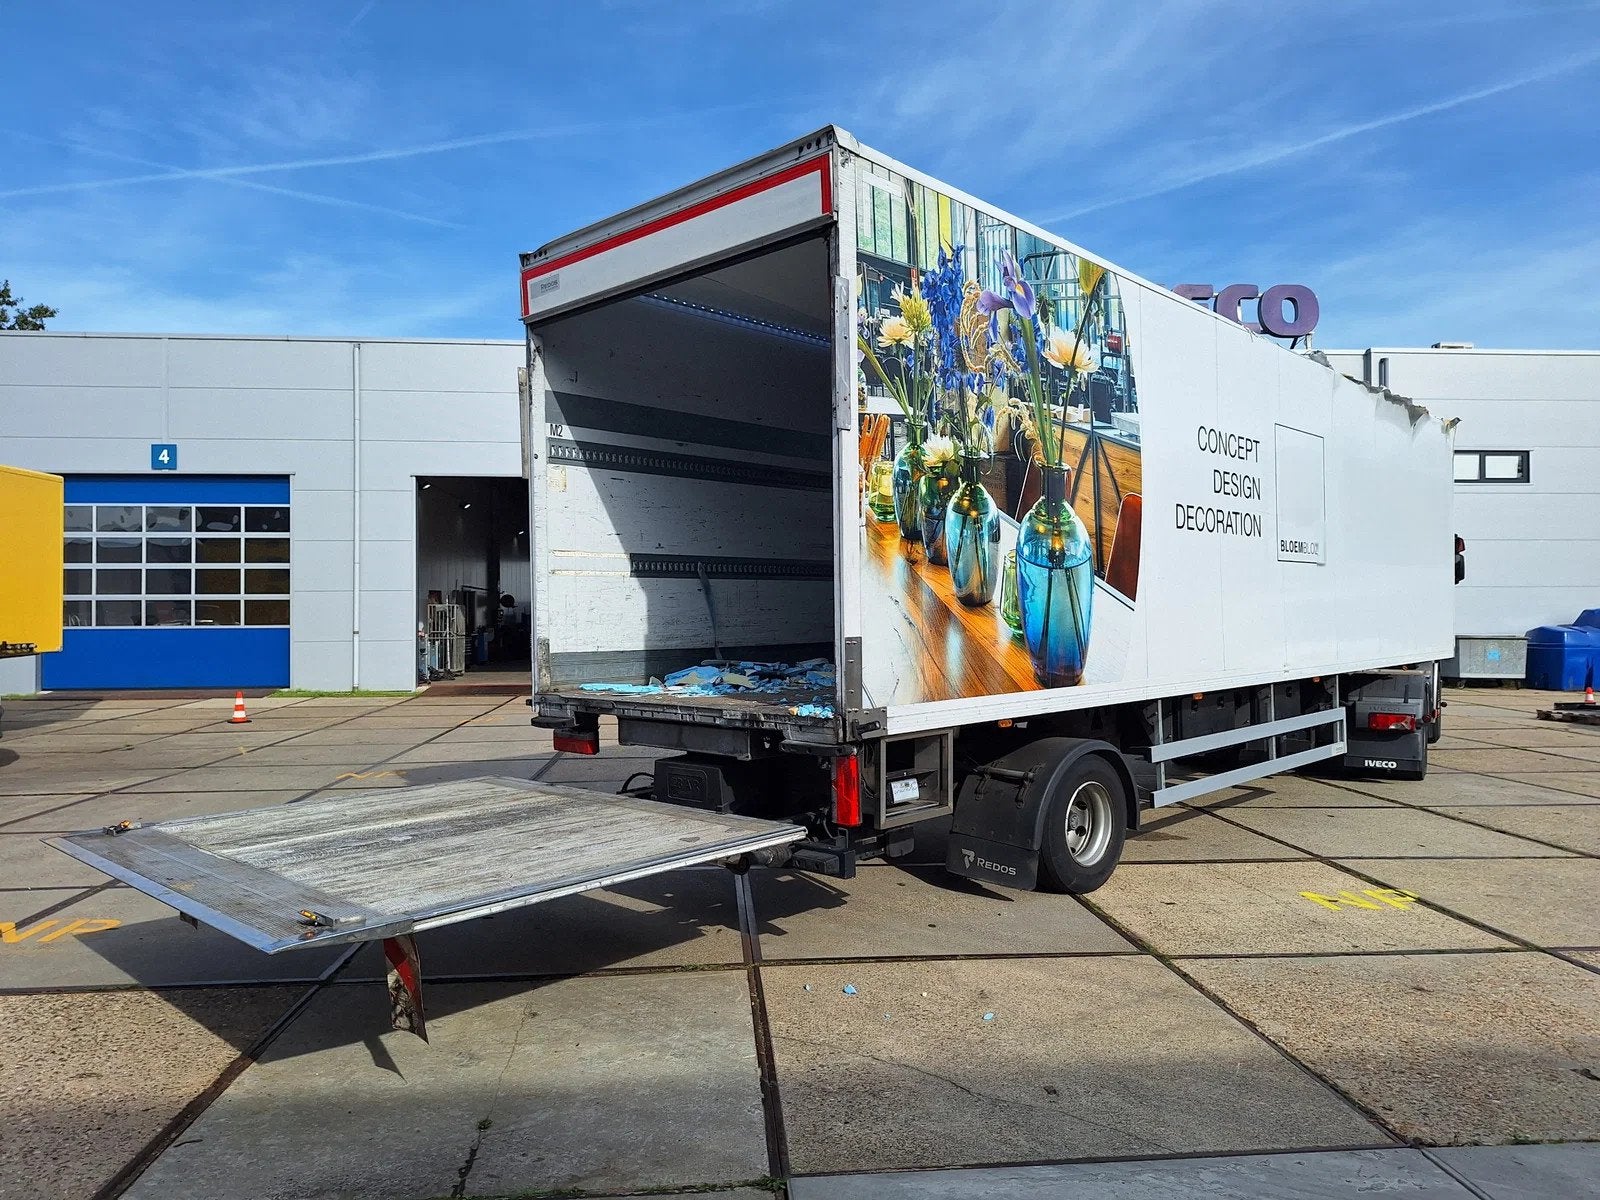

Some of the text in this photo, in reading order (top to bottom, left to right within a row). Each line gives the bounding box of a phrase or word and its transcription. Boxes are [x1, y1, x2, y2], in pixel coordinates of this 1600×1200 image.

[550, 423, 563, 438] M2
[1197, 425, 1260, 463] CONCEPT
[158, 449, 170, 464] 4
[1213, 469, 1261, 501] DESIGN
[1175, 503, 1262, 538] DECORATION
[1364, 760, 1397, 769] IVECO
[977, 857, 1017, 876] REDOS
